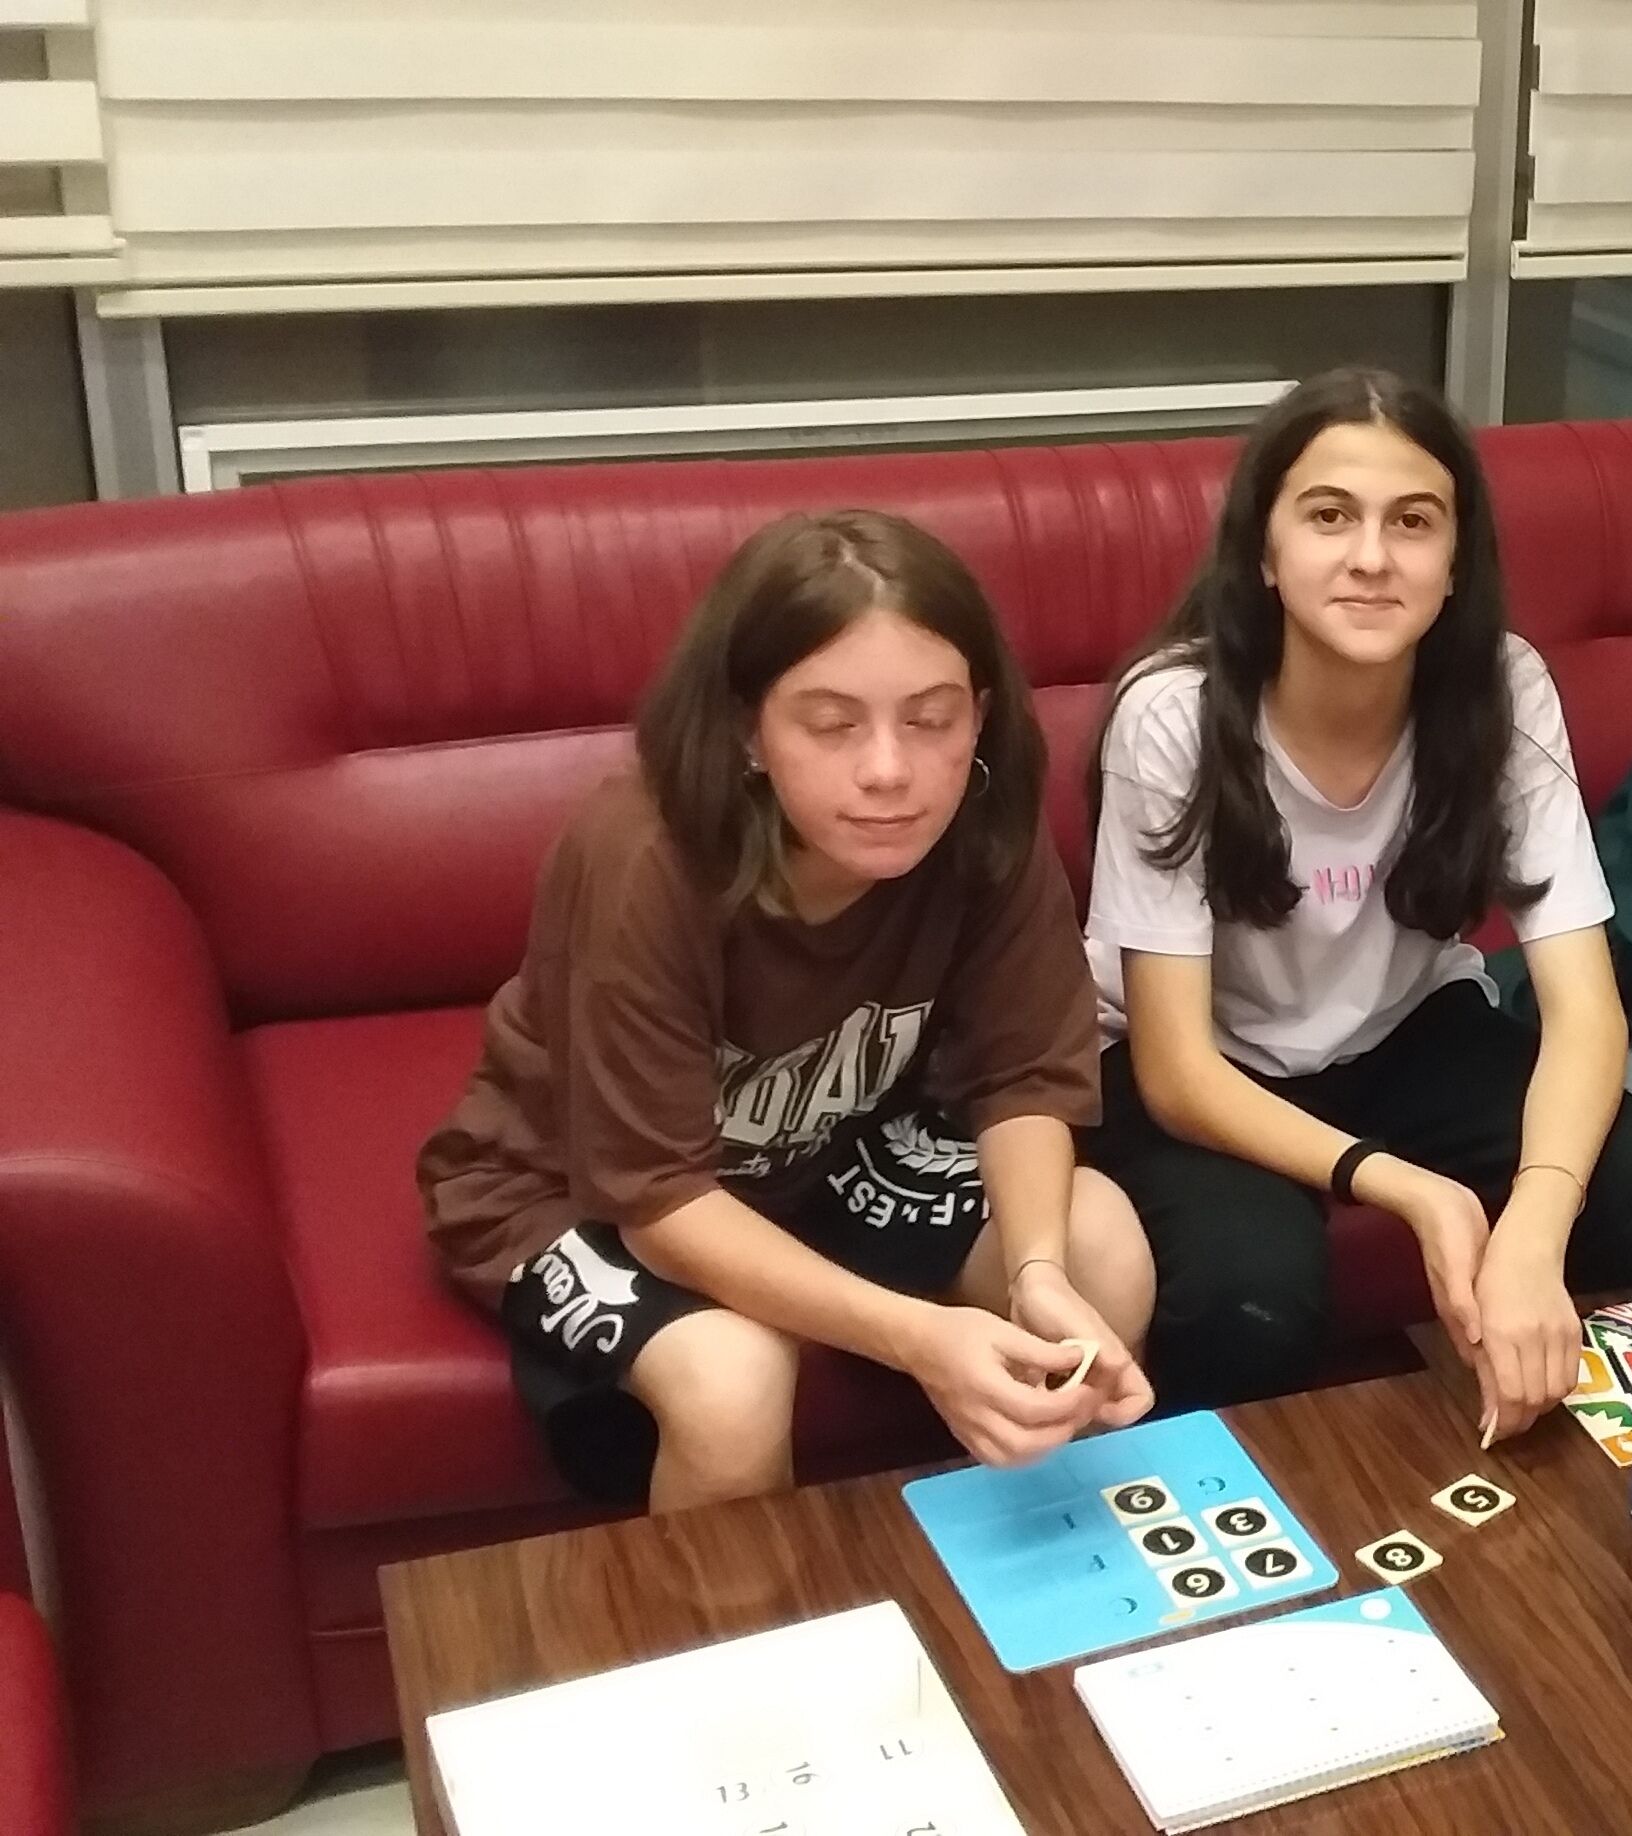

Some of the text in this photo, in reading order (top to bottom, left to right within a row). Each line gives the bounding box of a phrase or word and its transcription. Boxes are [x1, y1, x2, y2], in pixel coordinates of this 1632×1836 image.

[1463, 1489, 1491, 1509] 5
[1229, 1511, 1255, 1532] 3
[1160, 1532, 1181, 1552] 1
[1265, 1553, 1286, 1574] 7
[1385, 1547, 1413, 1567] 8
[1186, 1573, 1211, 1594] 6
[715, 1782, 750, 1804] 13
